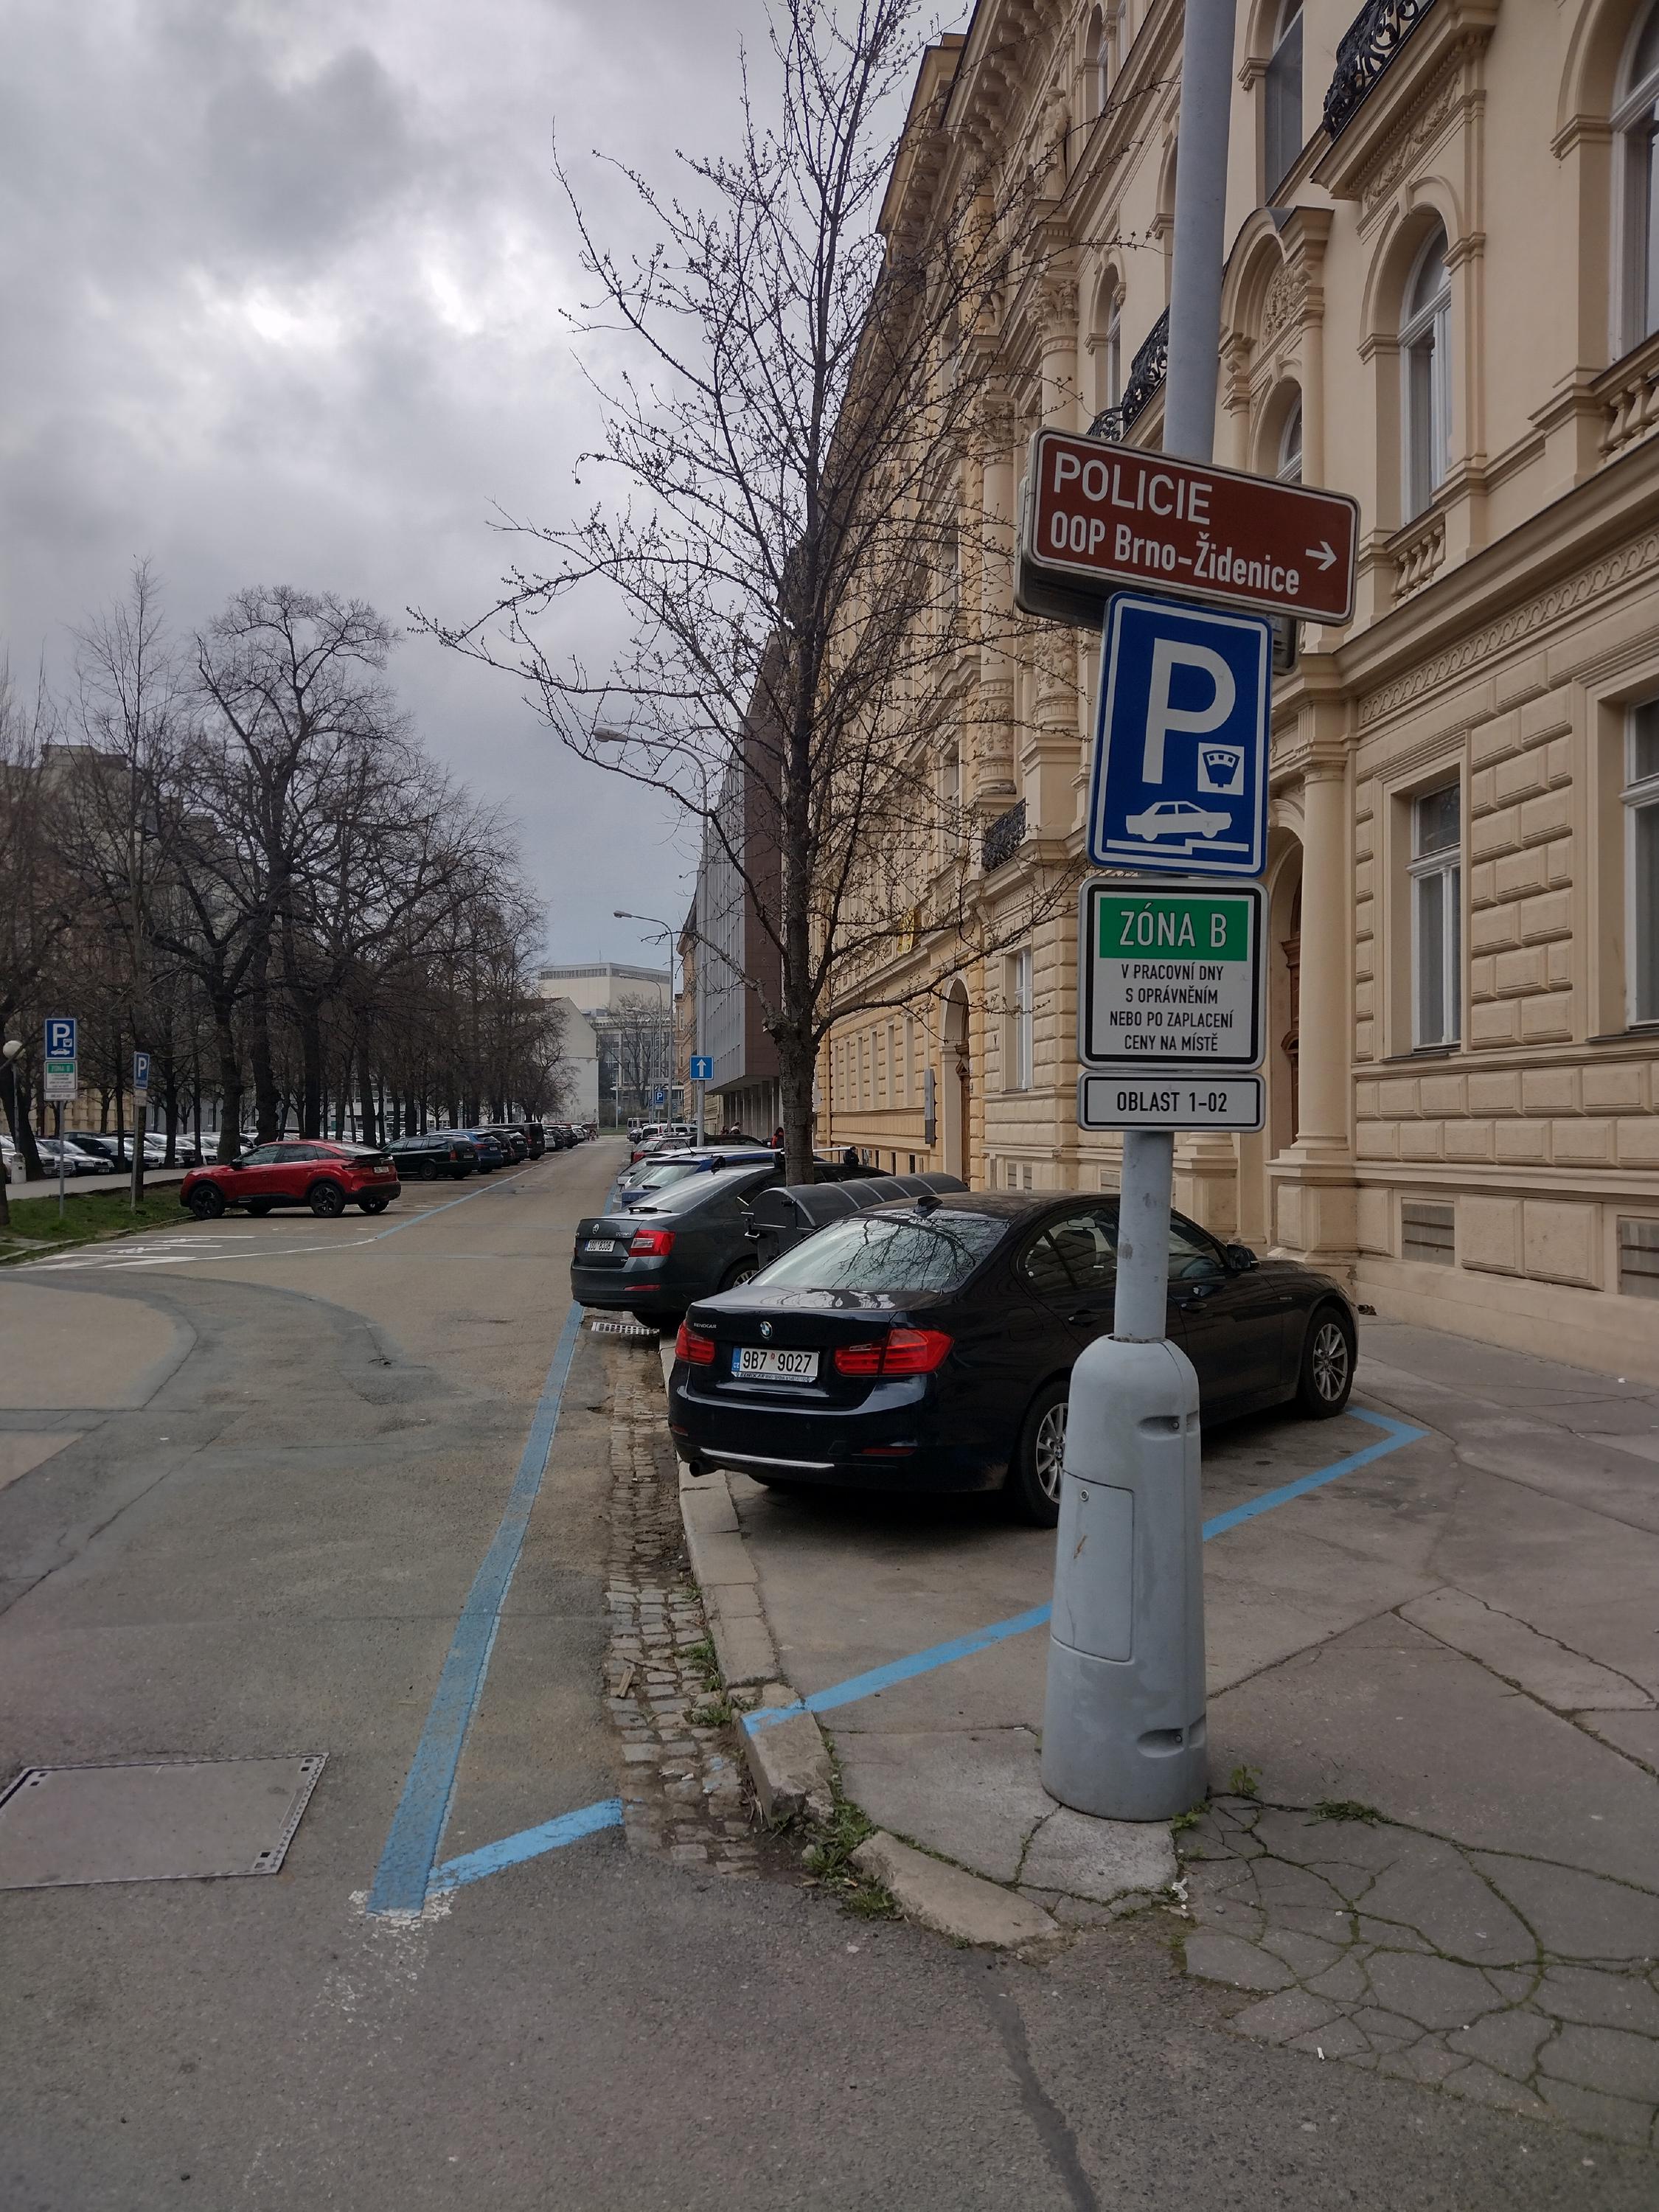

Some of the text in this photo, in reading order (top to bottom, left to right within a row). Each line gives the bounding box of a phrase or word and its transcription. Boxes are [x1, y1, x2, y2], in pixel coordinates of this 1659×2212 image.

[1054, 451, 1213, 525] POLICIE
[1050, 510, 1300, 595] OOP Brno-Židenice
[1142, 638, 1236, 785] P
[1119, 902, 1227, 948] ZÓNA B
[1121, 962, 1224, 981] V PRACOVNÍ DNY
[1125, 984, 1218, 1004] S OPRÁVNĚNÍM
[1110, 1009, 1234, 1029] NEBO PO ZAPLACENÍ
[52, 1023, 71, 1047] P
[1124, 1032, 1219, 1051] CENY NA MÍSTĚ
[139, 1057, 147, 1077] P
[1116, 1091, 1228, 1113] OBLAST 1-02
[742, 1351, 768, 1370] 9B7
[777, 1353, 813, 1374] 9027
